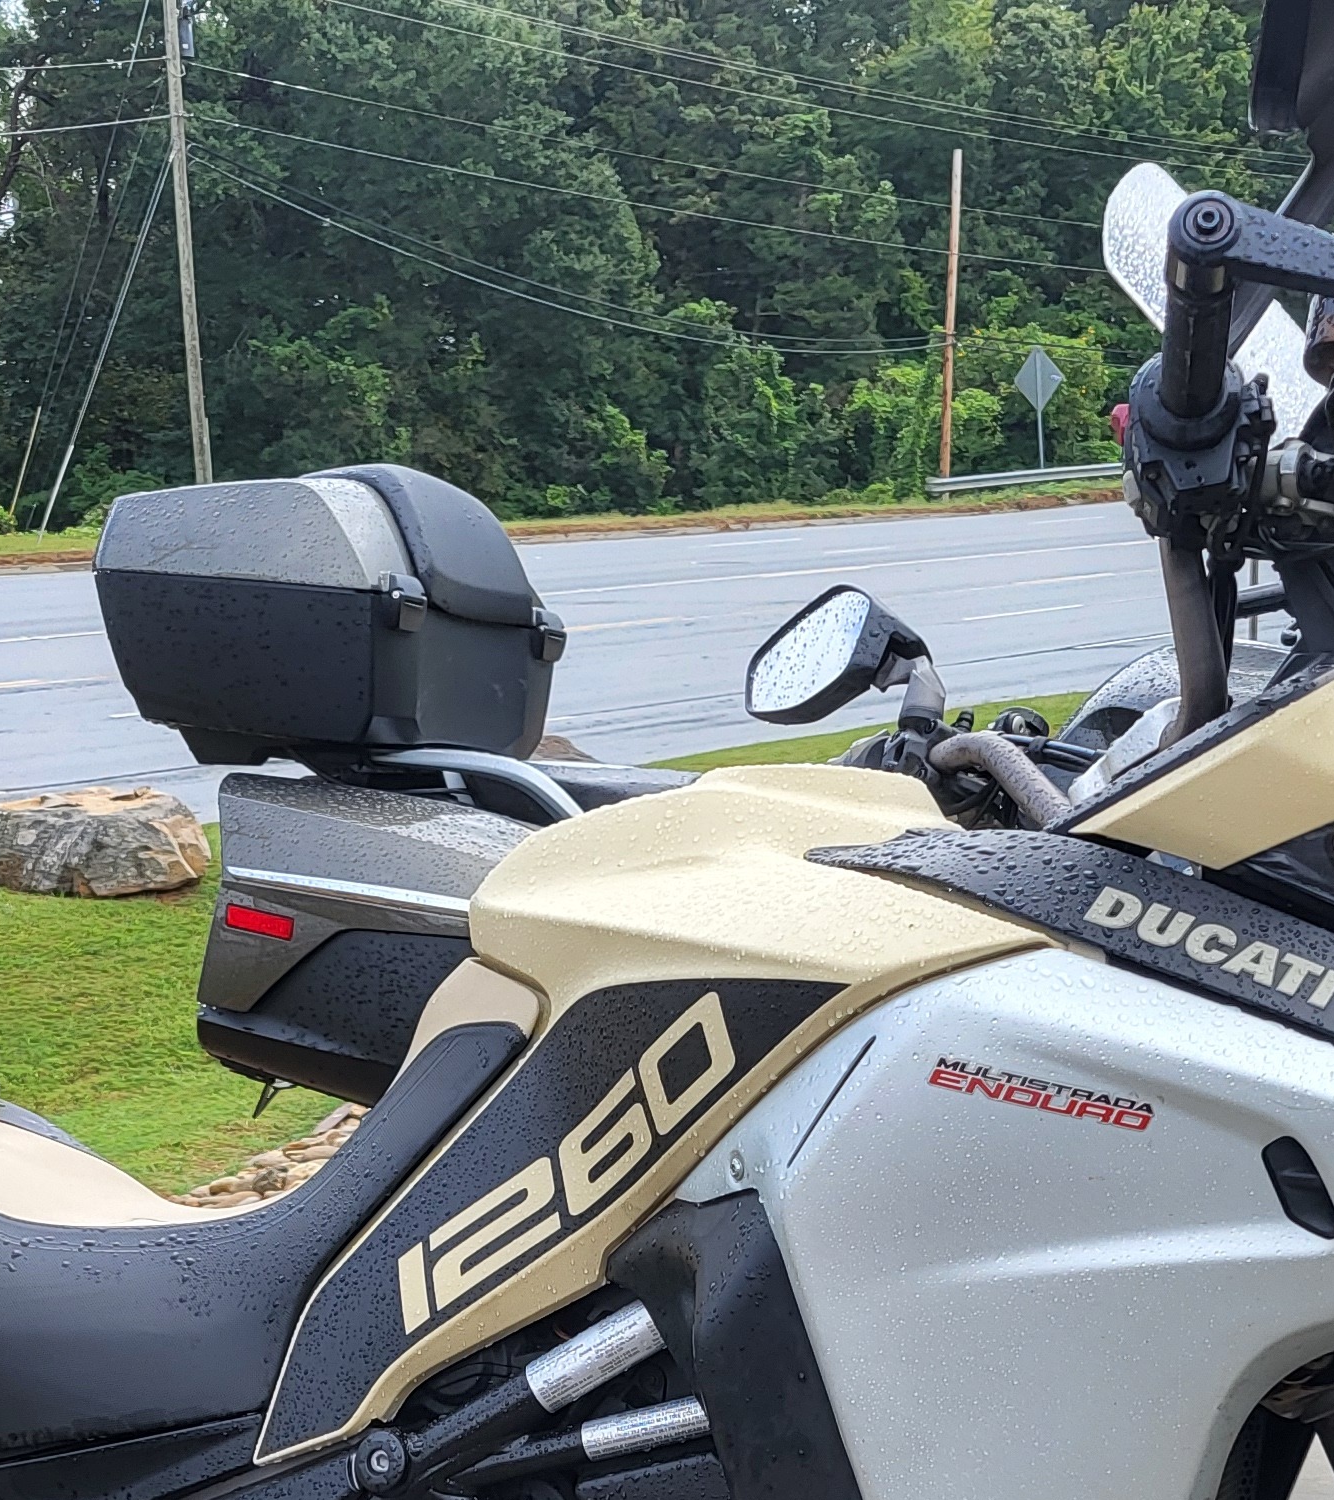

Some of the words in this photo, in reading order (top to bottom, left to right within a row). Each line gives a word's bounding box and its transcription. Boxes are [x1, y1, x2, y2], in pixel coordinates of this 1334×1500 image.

[928, 1069, 1153, 1131] ENDURO
[936, 1058, 1154, 1115] MULTISTRADA
[398, 991, 736, 1335] 1260
